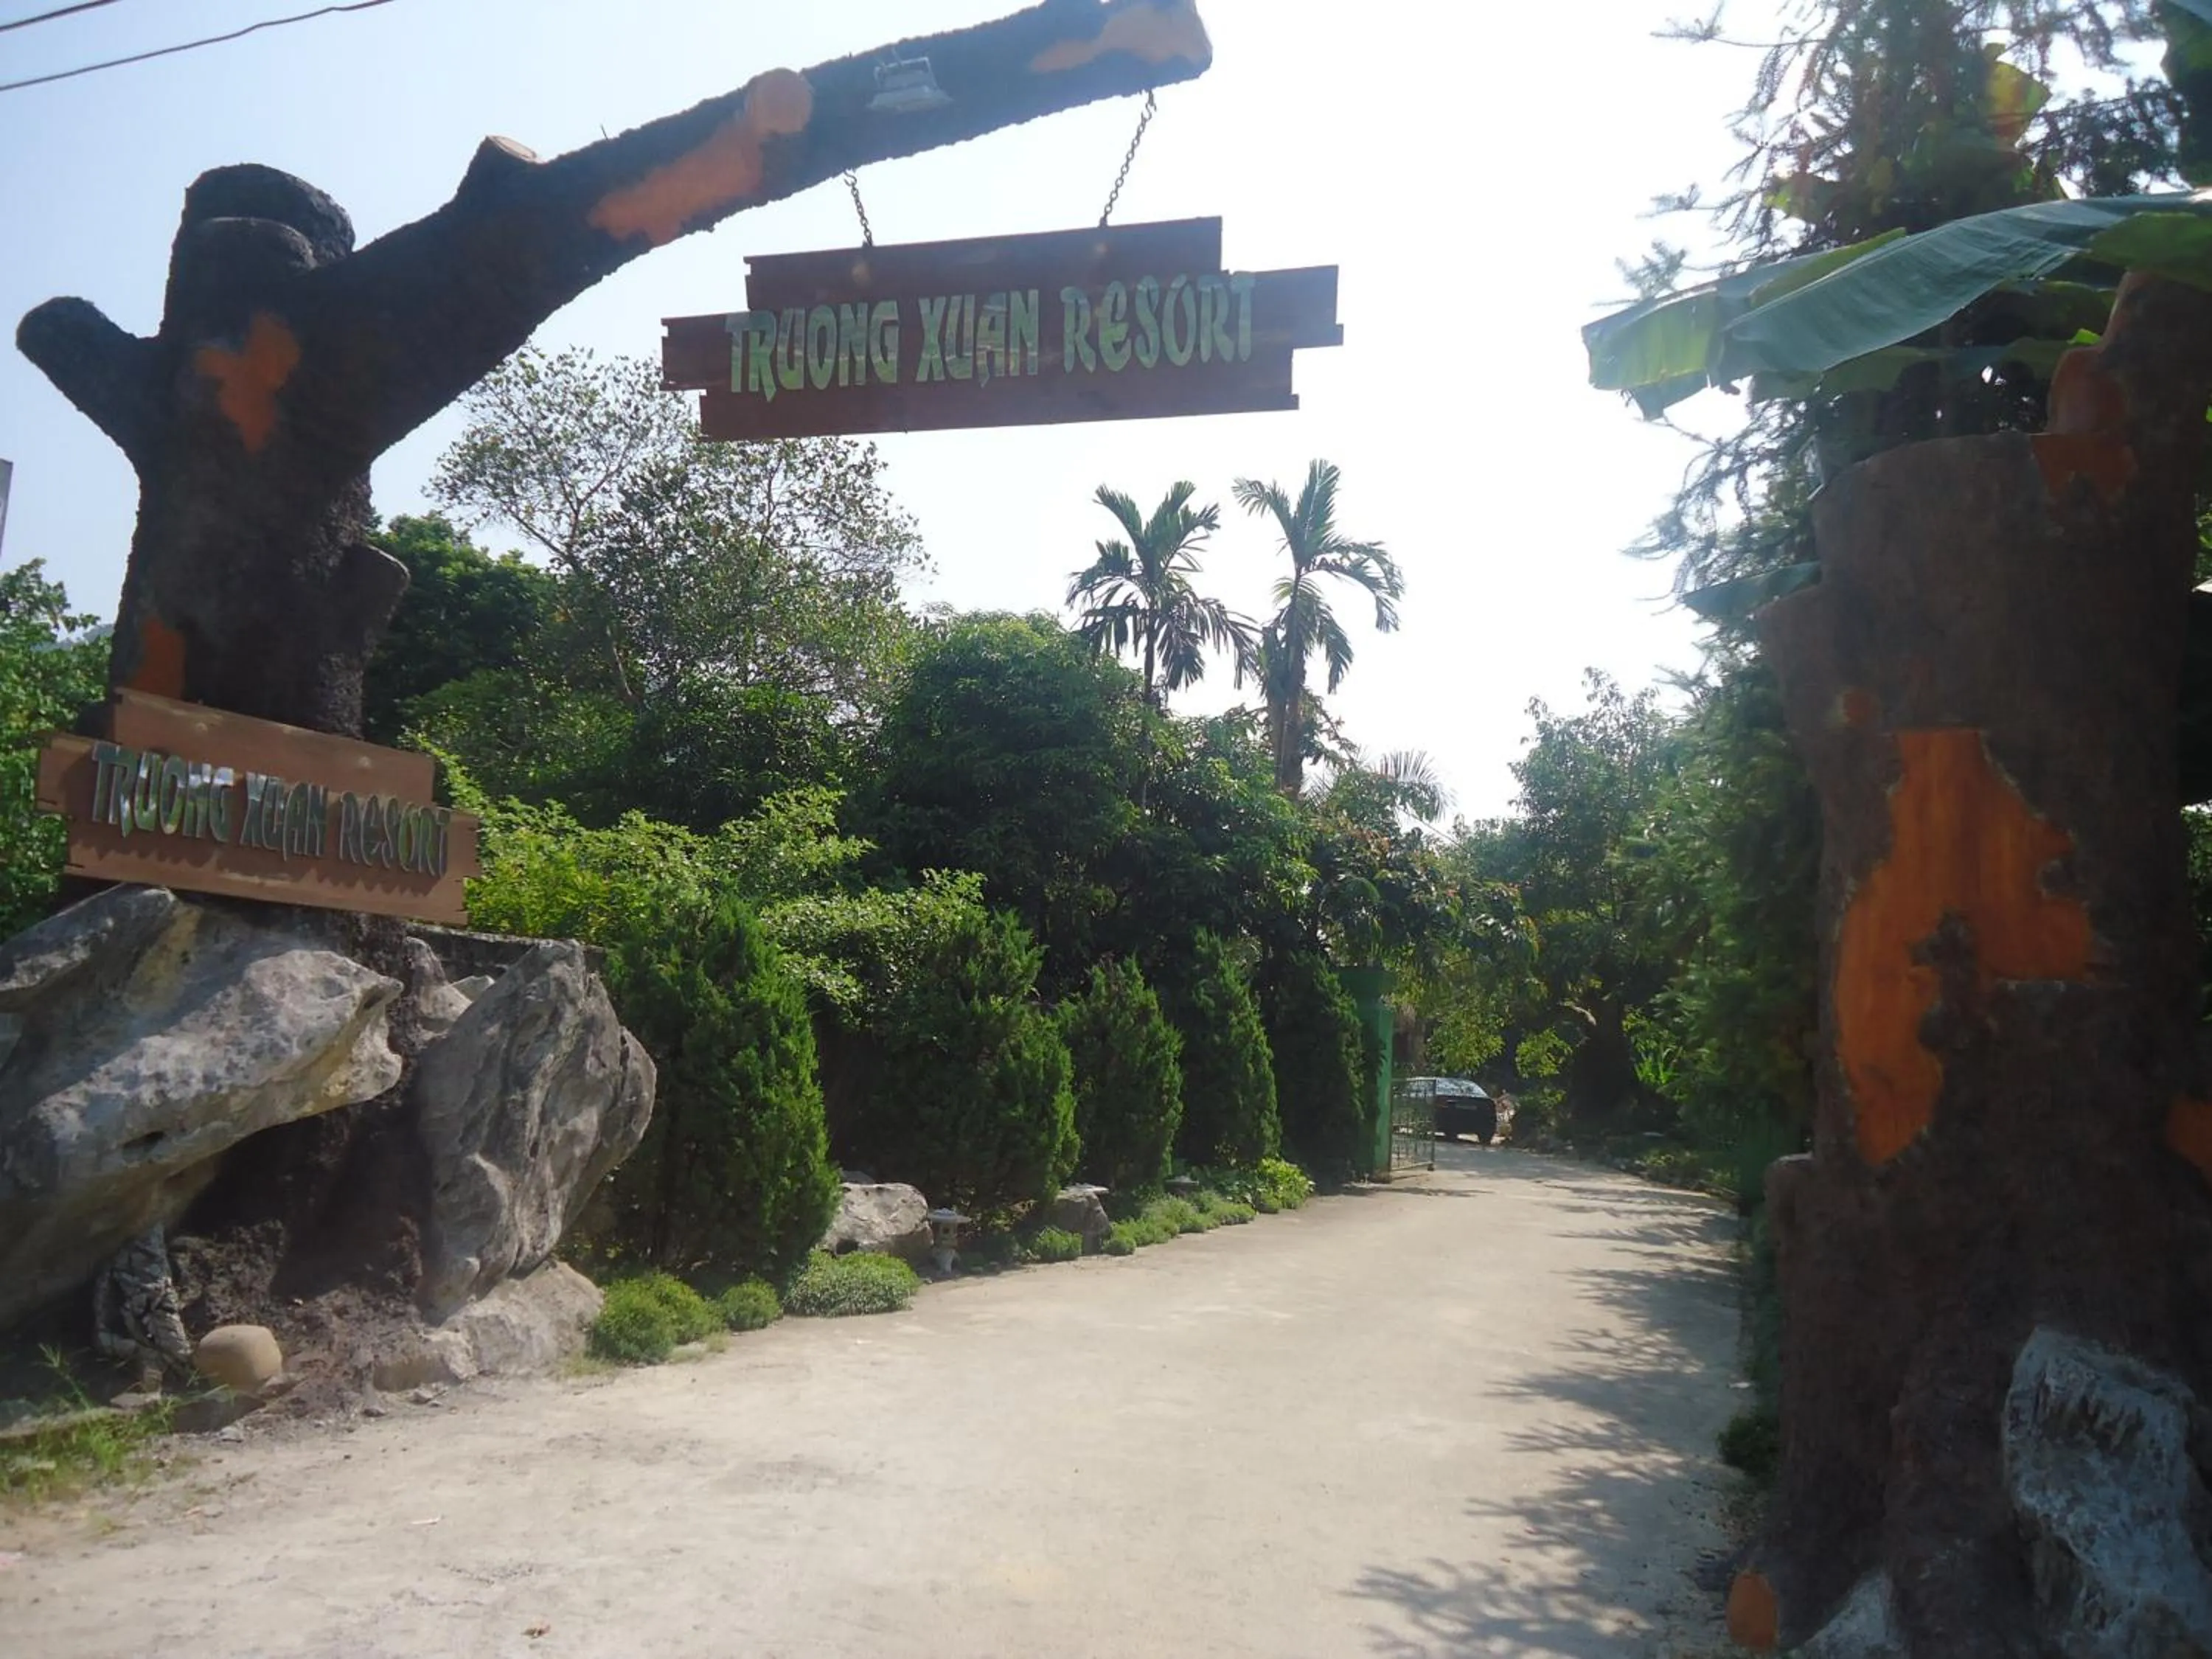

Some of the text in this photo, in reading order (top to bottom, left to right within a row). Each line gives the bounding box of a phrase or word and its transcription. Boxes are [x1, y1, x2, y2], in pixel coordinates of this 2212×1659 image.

[725, 271, 1256, 402] TRUONG XUAN RESORT
[91, 740, 234, 843] TRUONG
